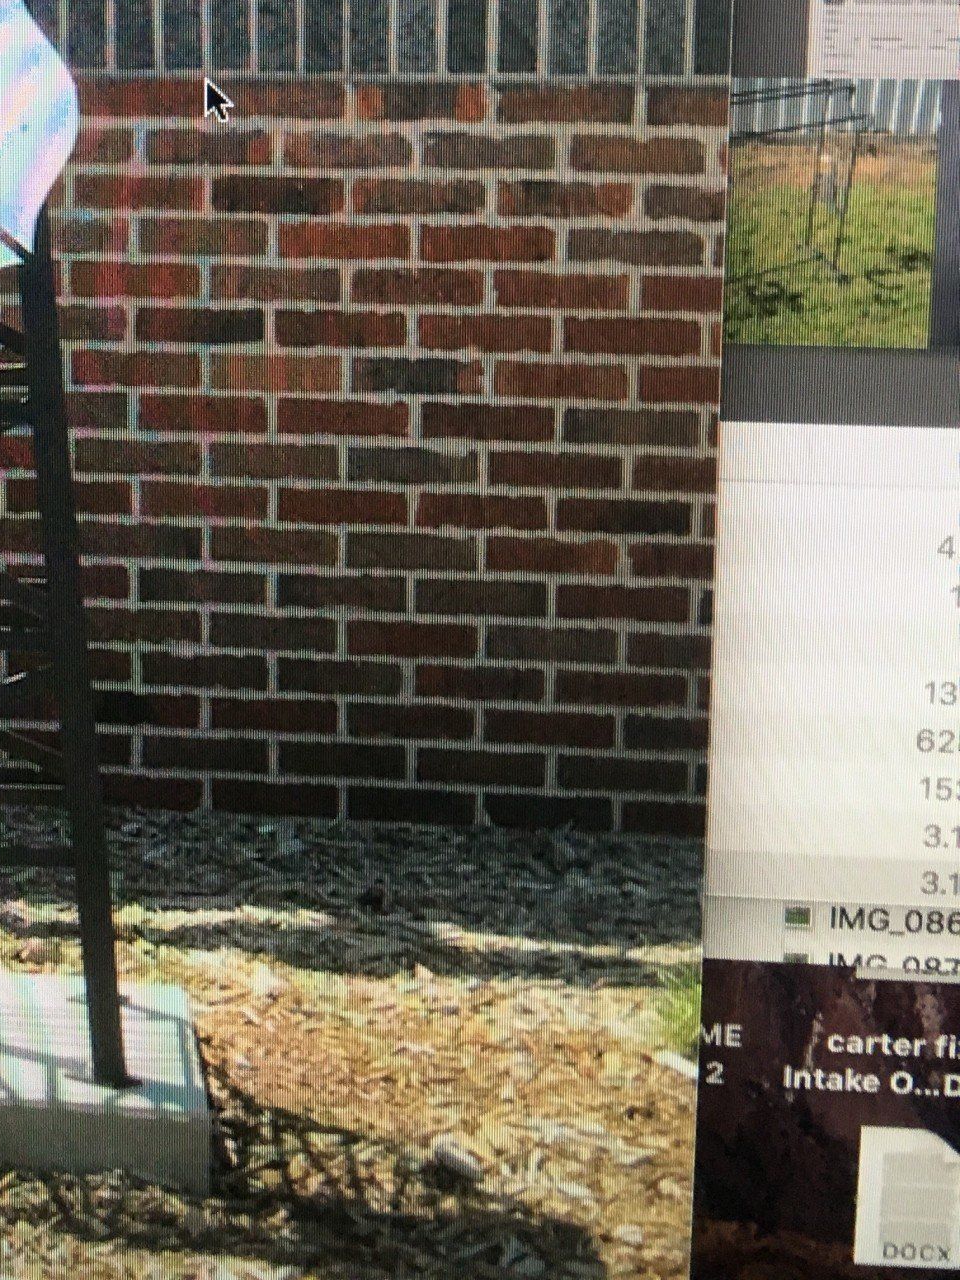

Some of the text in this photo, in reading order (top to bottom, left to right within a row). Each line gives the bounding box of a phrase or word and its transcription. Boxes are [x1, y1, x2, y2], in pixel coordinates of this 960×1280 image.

[916, 728, 960, 754] 62
[919, 776, 960, 801] 15
[827, 1032, 960, 1060] carter fi
[705, 1060, 724, 1084] 2
[783, 1064, 881, 1093] Intake
[882, 1240, 951, 1261] DOCX
